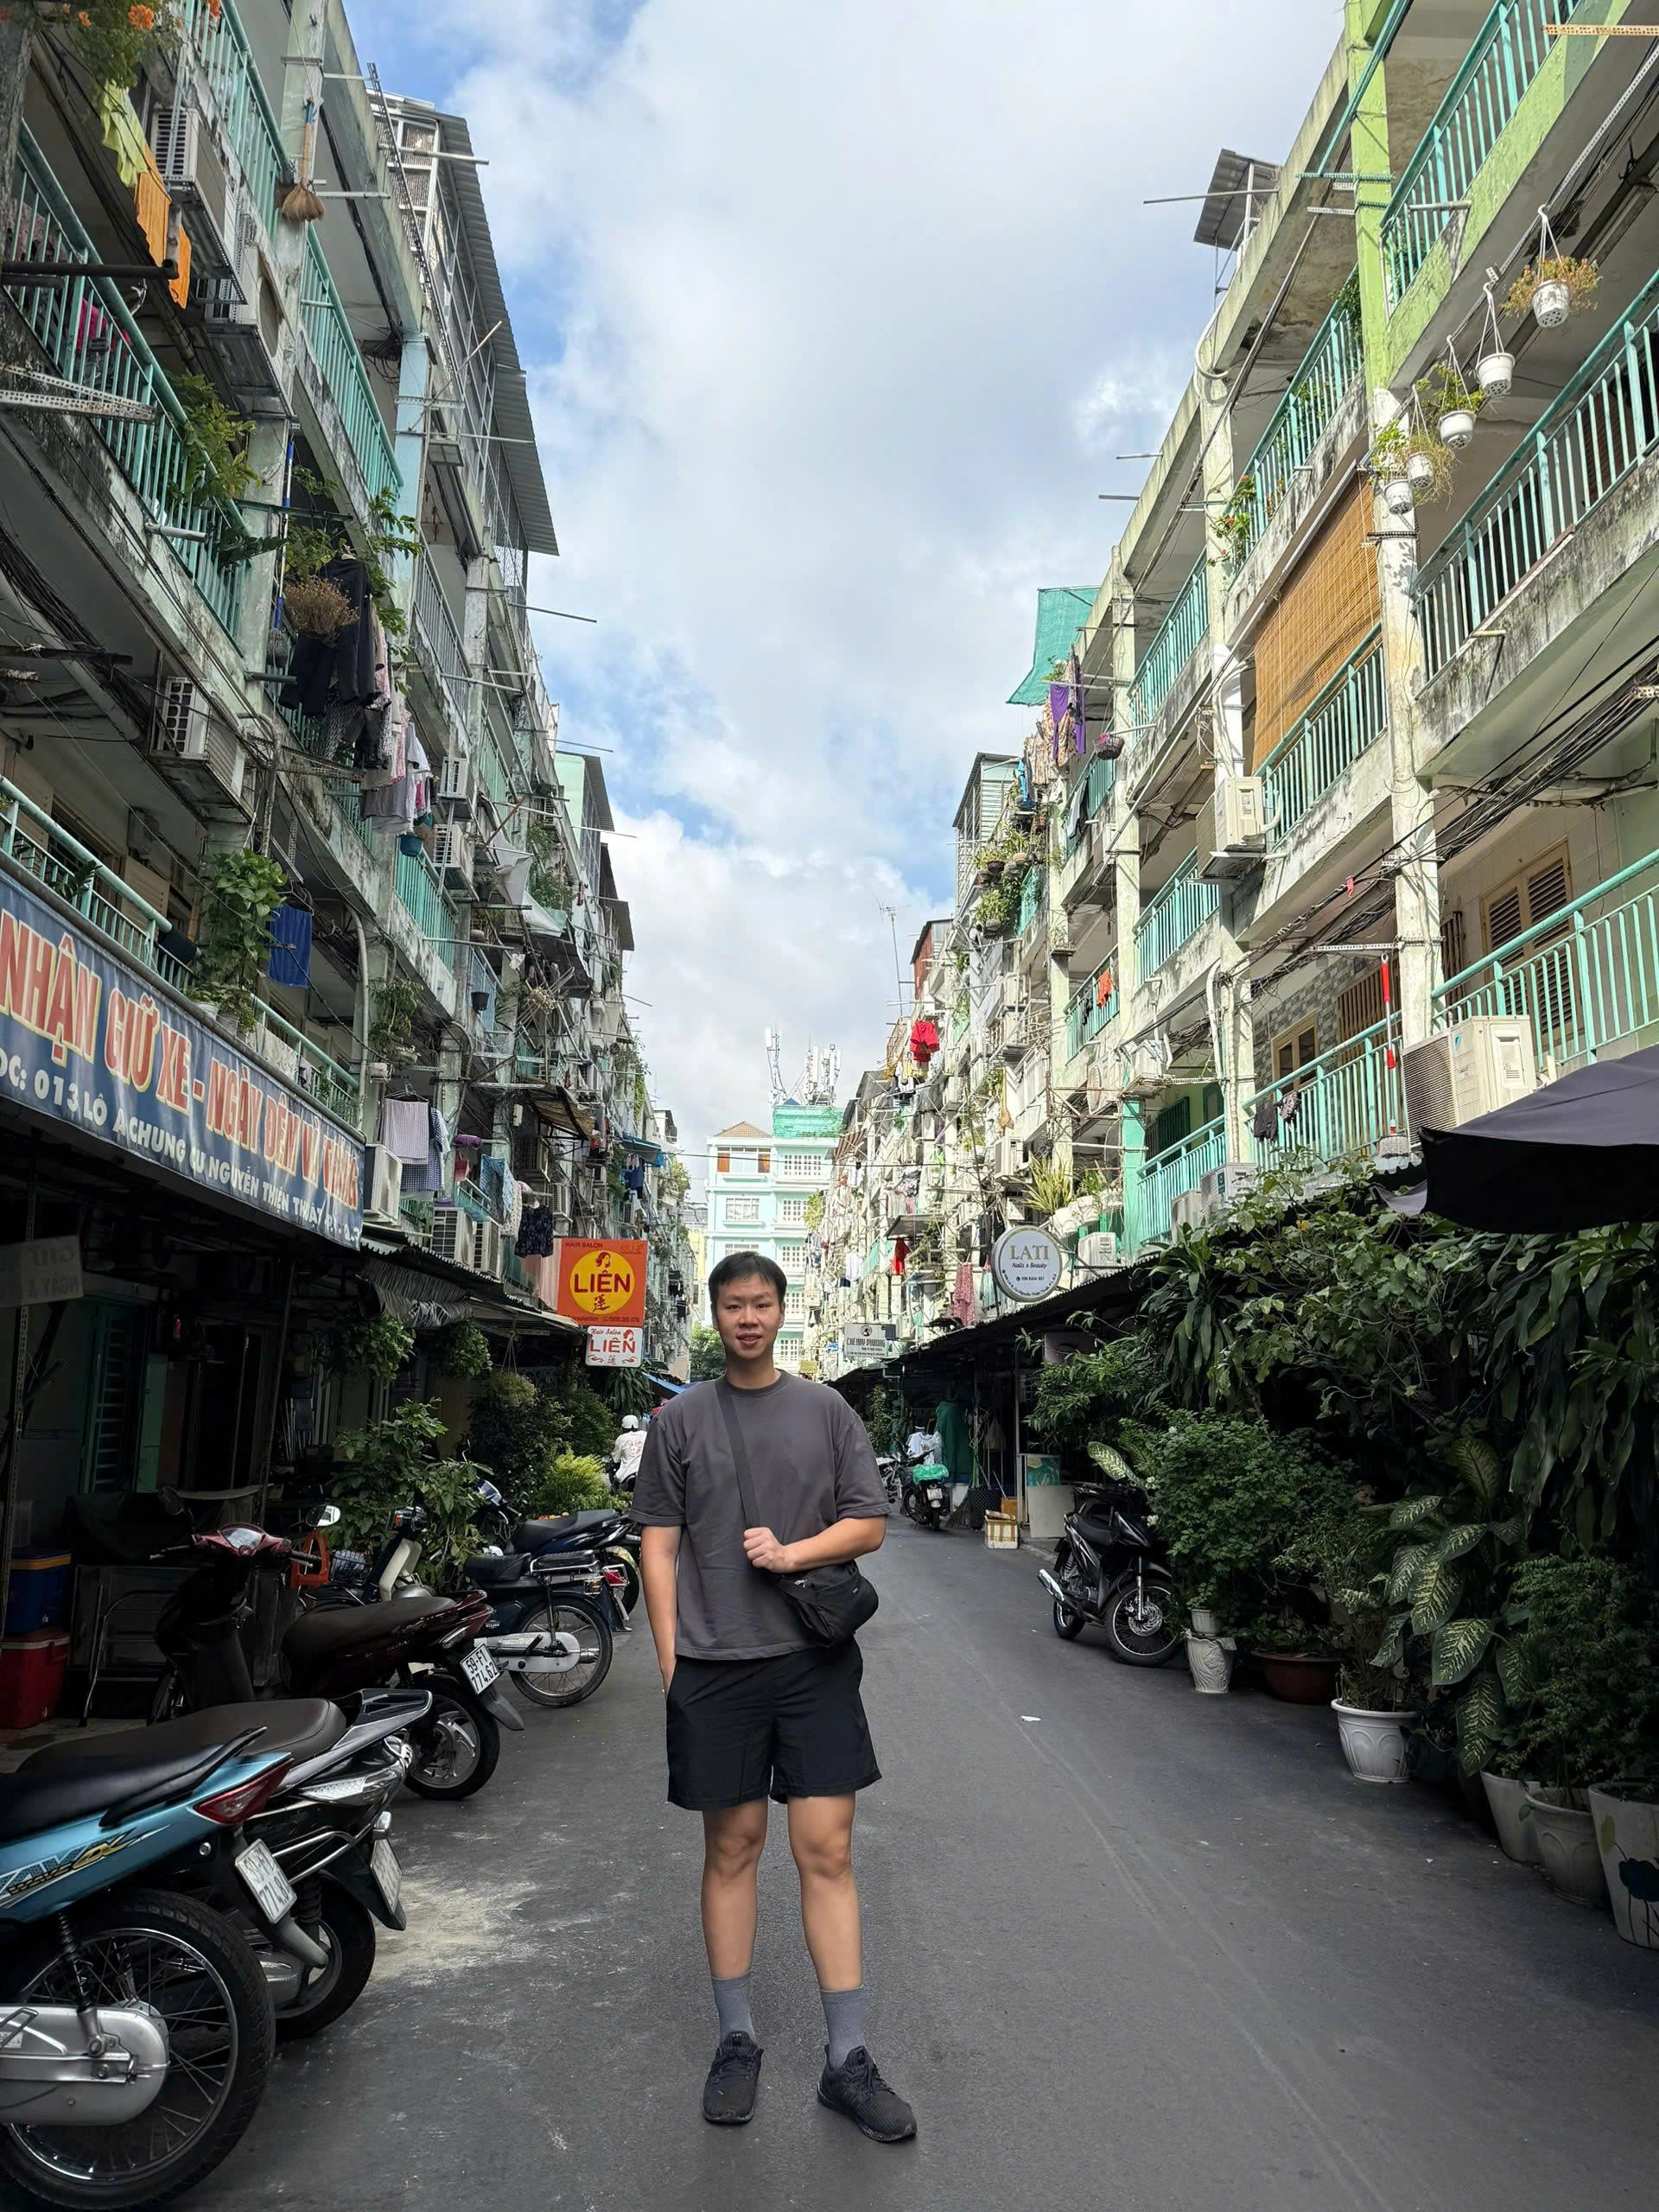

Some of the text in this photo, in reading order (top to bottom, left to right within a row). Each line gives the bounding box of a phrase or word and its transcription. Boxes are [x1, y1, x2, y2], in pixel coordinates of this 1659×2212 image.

[0, 908, 103, 1068] NHẬN
[156, 1023, 192, 1116] XE
[207, 1058, 263, 1154] NGÀY
[83, 1092, 107, 1126] LÔ
[113, 1109, 125, 1136] A
[129, 1116, 187, 1163] CHUNG
[1009, 1245, 1049, 1260] LATI
[574, 1269, 631, 1294] LIÊN
[589, 1338, 636, 1353] LIÊN
[465, 1649, 488, 1674] 59-F1
[471, 1661, 498, 1692] 774.62
